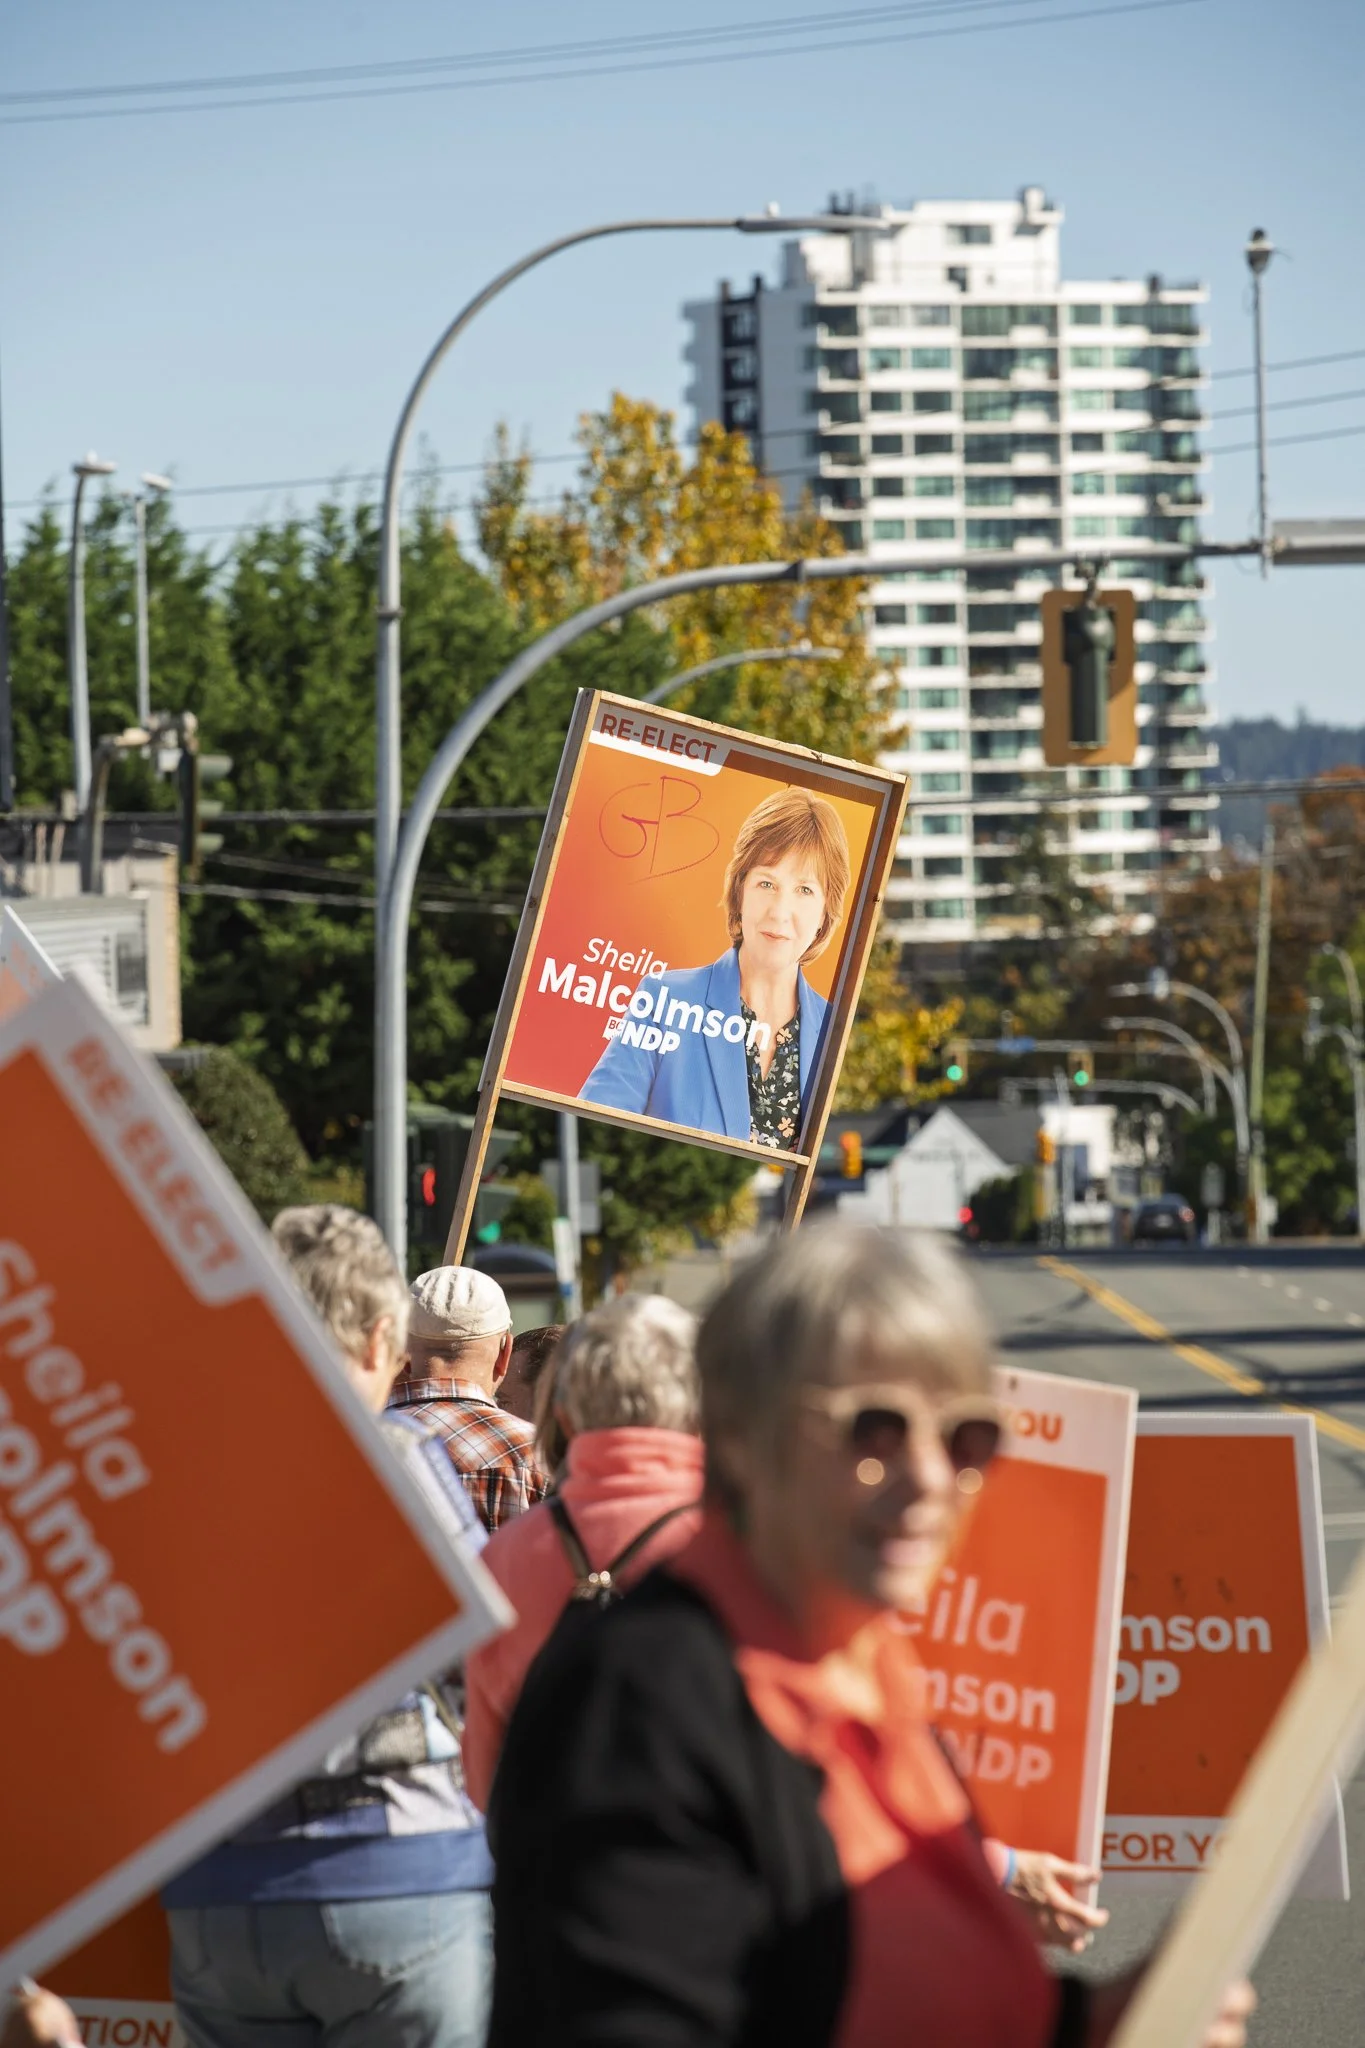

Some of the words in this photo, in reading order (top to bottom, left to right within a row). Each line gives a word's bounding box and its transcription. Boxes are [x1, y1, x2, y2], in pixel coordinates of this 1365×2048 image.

[600, 713, 717, 764] RE-ELECT
[583, 937, 669, 980] Sheila
[538, 957, 771, 1051] Malcolmson
[620, 1020, 681, 1055] NDP
[1102, 1831, 1175, 1863] FOR
